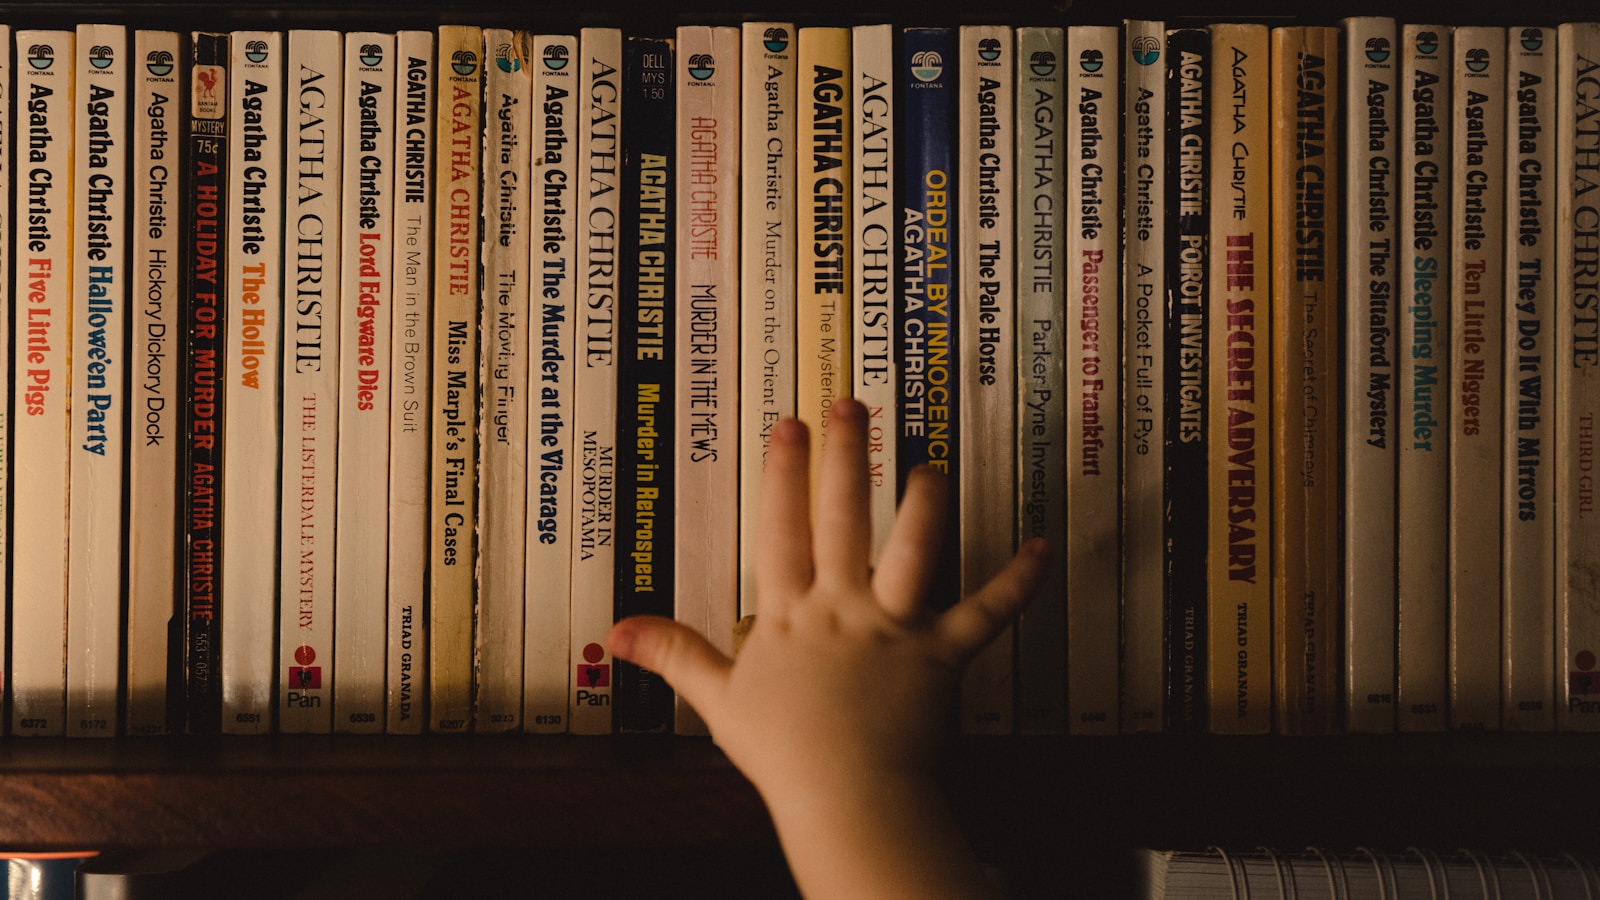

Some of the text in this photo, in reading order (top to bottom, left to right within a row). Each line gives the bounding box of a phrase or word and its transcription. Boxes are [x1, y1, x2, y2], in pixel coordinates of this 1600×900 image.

[641, 73, 665, 84] MYS
[642, 54, 665, 69] DELL
[88, 85, 114, 168] Agatha
[191, 120, 225, 134] MYSTERY
[197, 161, 218, 176] A
[451, 85, 471, 182] AGATHA
[25, 84, 53, 416] Agatha Christie Five Little Pigs
[88, 174, 113, 261] Christie
[195, 185, 218, 284] HOLIDAY
[241, 80, 268, 389] Agatha Christie The Hollow
[357, 81, 382, 411] Agatha Christie Lord Edgware Dies
[403, 57, 427, 433] AGATHA CHRISTIE The Man in the Brown Suit
[449, 189, 470, 295] CHRISTIE
[763, 65, 784, 405] Agatha Christie Murder the Orient
[813, 65, 843, 333] AGATHA CHRISTIE The
[925, 169, 947, 277] ORDEAL
[978, 77, 1001, 386] Agatha Christie The Pale Horse
[1180, 51, 1203, 443] AGATHA CHRISTIE POIROT INVESTIGATES
[144, 92, 168, 446] Agatha Christie Hickory Dickory Dock
[194, 292, 217, 339] FOR
[537, 84, 569, 544] Agatha Christie The Murder at the Vicarage
[587, 58, 617, 528] AGATHA CHRISTIE MURDER
[691, 117, 718, 463] AGATHA CHRISTIE MURDER IN THE MEWS
[928, 283, 948, 317] BY
[1027, 89, 1053, 436] AGATHA CHRISTIE Parker Pyne
[1079, 87, 1104, 476] Agatha Christie Passenger Frankfurt
[1134, 87, 1154, 456] Agatha Christie Pocket Full Rye
[1226, 46, 1256, 584] AGATHA CHRISTIE THE SECRET ADVERSARY
[1367, 79, 1391, 449] Agatha Christie The Sittaford Mystery
[1409, 70, 1439, 452] Agatha Christie Sleeping Murder
[1462, 90, 1489, 436] Agatha Christie Ten Little Niggers
[1516, 71, 1542, 522] Agatha Christie They Do With Mirrors
[296, 64, 326, 631] AGATHA CHRISTIE THE LISTERDALE MYSTERY
[448, 321, 468, 364] Miss
[631, 153, 666, 594] AGATHA CHRISTIE Murder in Retrospect
[903, 207, 924, 437] AGATHA CHRISTIE
[82, 394, 112, 456] Party
[193, 349, 216, 449] MURDER
[192, 462, 215, 530] AGATHA
[446, 457, 465, 505] Final
[581, 430, 597, 561] MESOPOTAMIA
[192, 539, 214, 621] CHRISTIE
[444, 512, 464, 566] Cases
[287, 692, 321, 707] Pan
[400, 606, 412, 720] TRIAD GRANADA
[576, 690, 609, 706] Pan
[1237, 603, 1248, 718] TRIAD GRANADA
[81, 720, 107, 730] 6172
[236, 714, 260, 723] 6551
[350, 714, 375, 723] 6539
[536, 716, 560, 724] 6130
